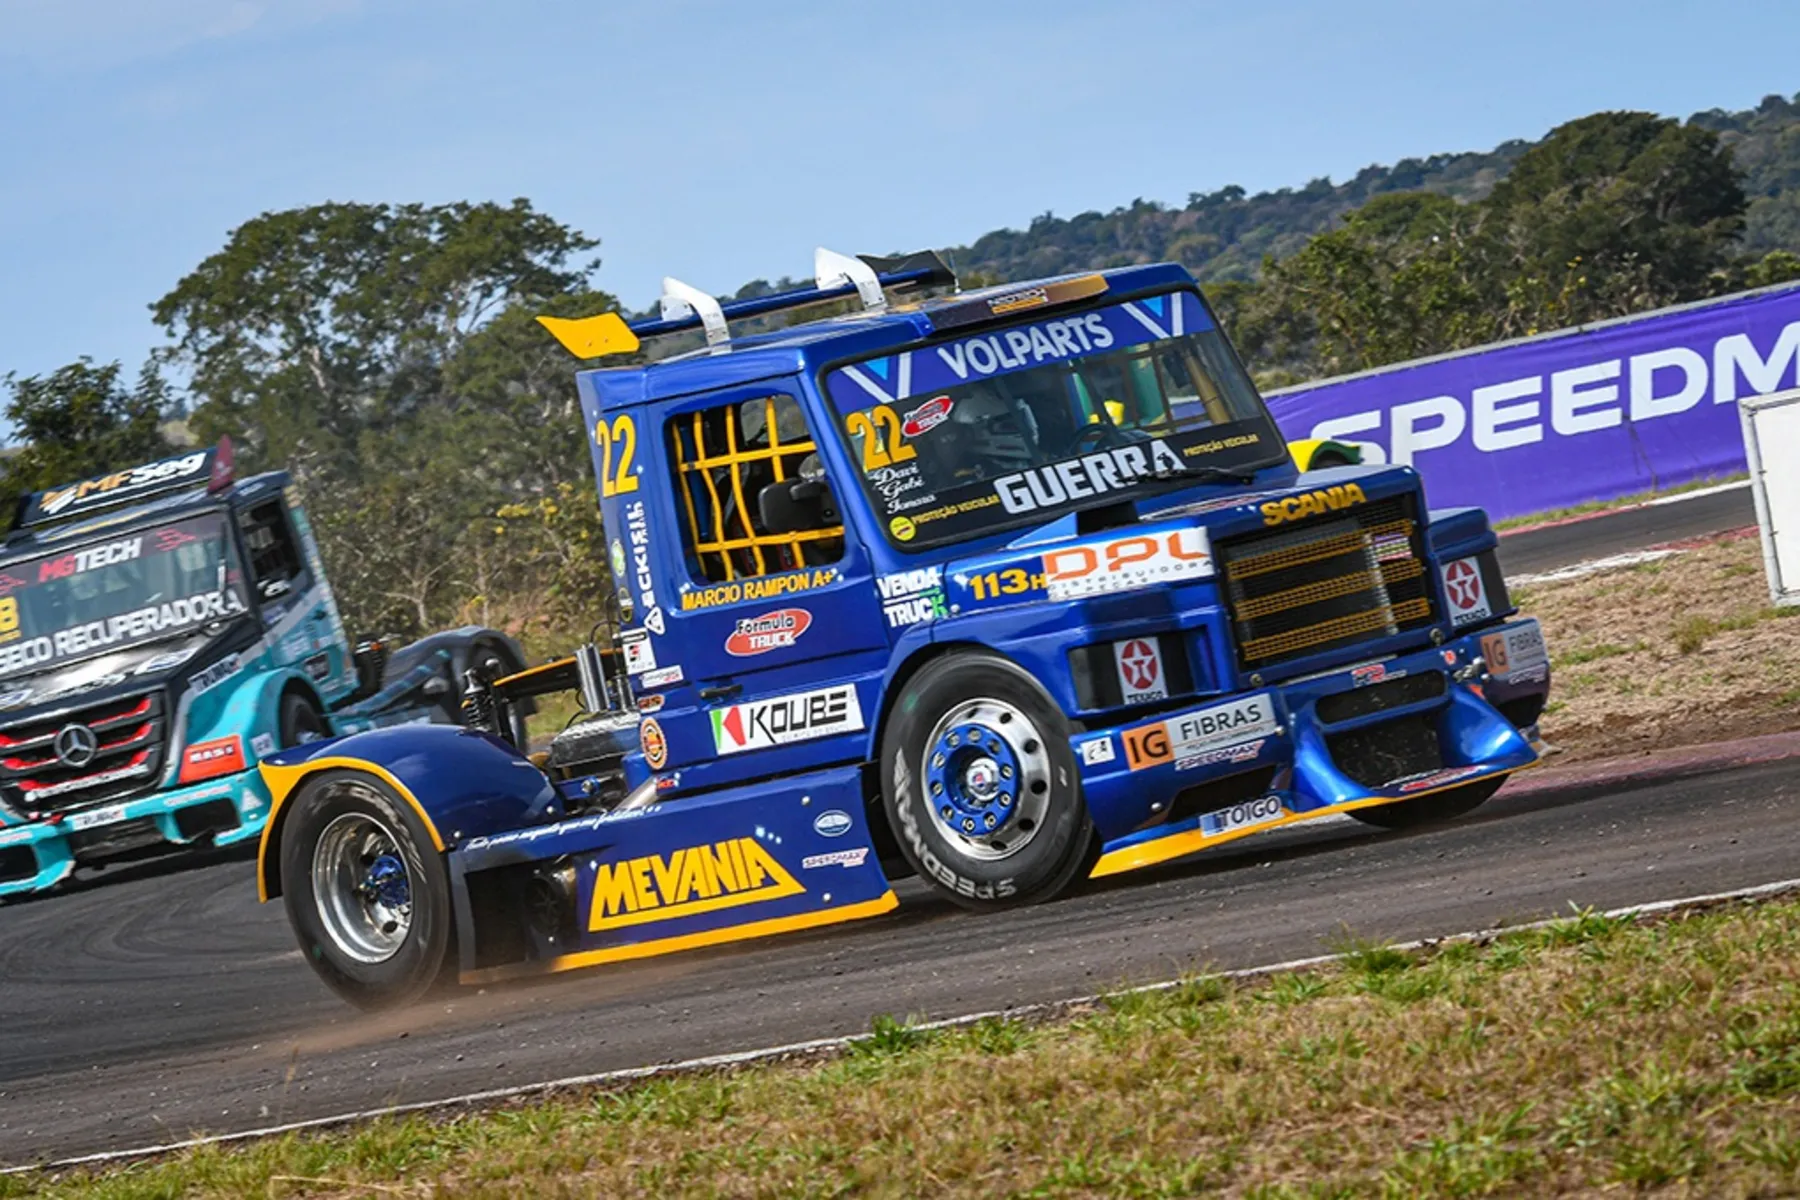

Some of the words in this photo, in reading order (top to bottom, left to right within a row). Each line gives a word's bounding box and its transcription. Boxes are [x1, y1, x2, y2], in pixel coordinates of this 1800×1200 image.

[937, 313, 1115, 380] VOLPARTS
[596, 414, 638, 498] 22
[845, 405, 918, 472] 22
[993, 438, 1187, 514] GUERRA
[1260, 483, 1367, 526] SCANIA
[37, 537, 143, 583] MGTECH
[1043, 532, 1209, 581] DPL
[682, 585, 741, 611] MARCIO
[743, 572, 809, 600] RAMPON
[876, 567, 941, 599] VENDA
[53, 590, 249, 657] RECUPERADORA
[736, 613, 795, 635] Formula
[883, 594, 947, 628] TRUCK
[749, 631, 796, 649] TRUCK
[1129, 730, 1169, 764] IG
[1181, 704, 1262, 740] FIBRAS
[1218, 796, 1281, 828] TOIGO
[592, 836, 806, 930] MEVANIA
